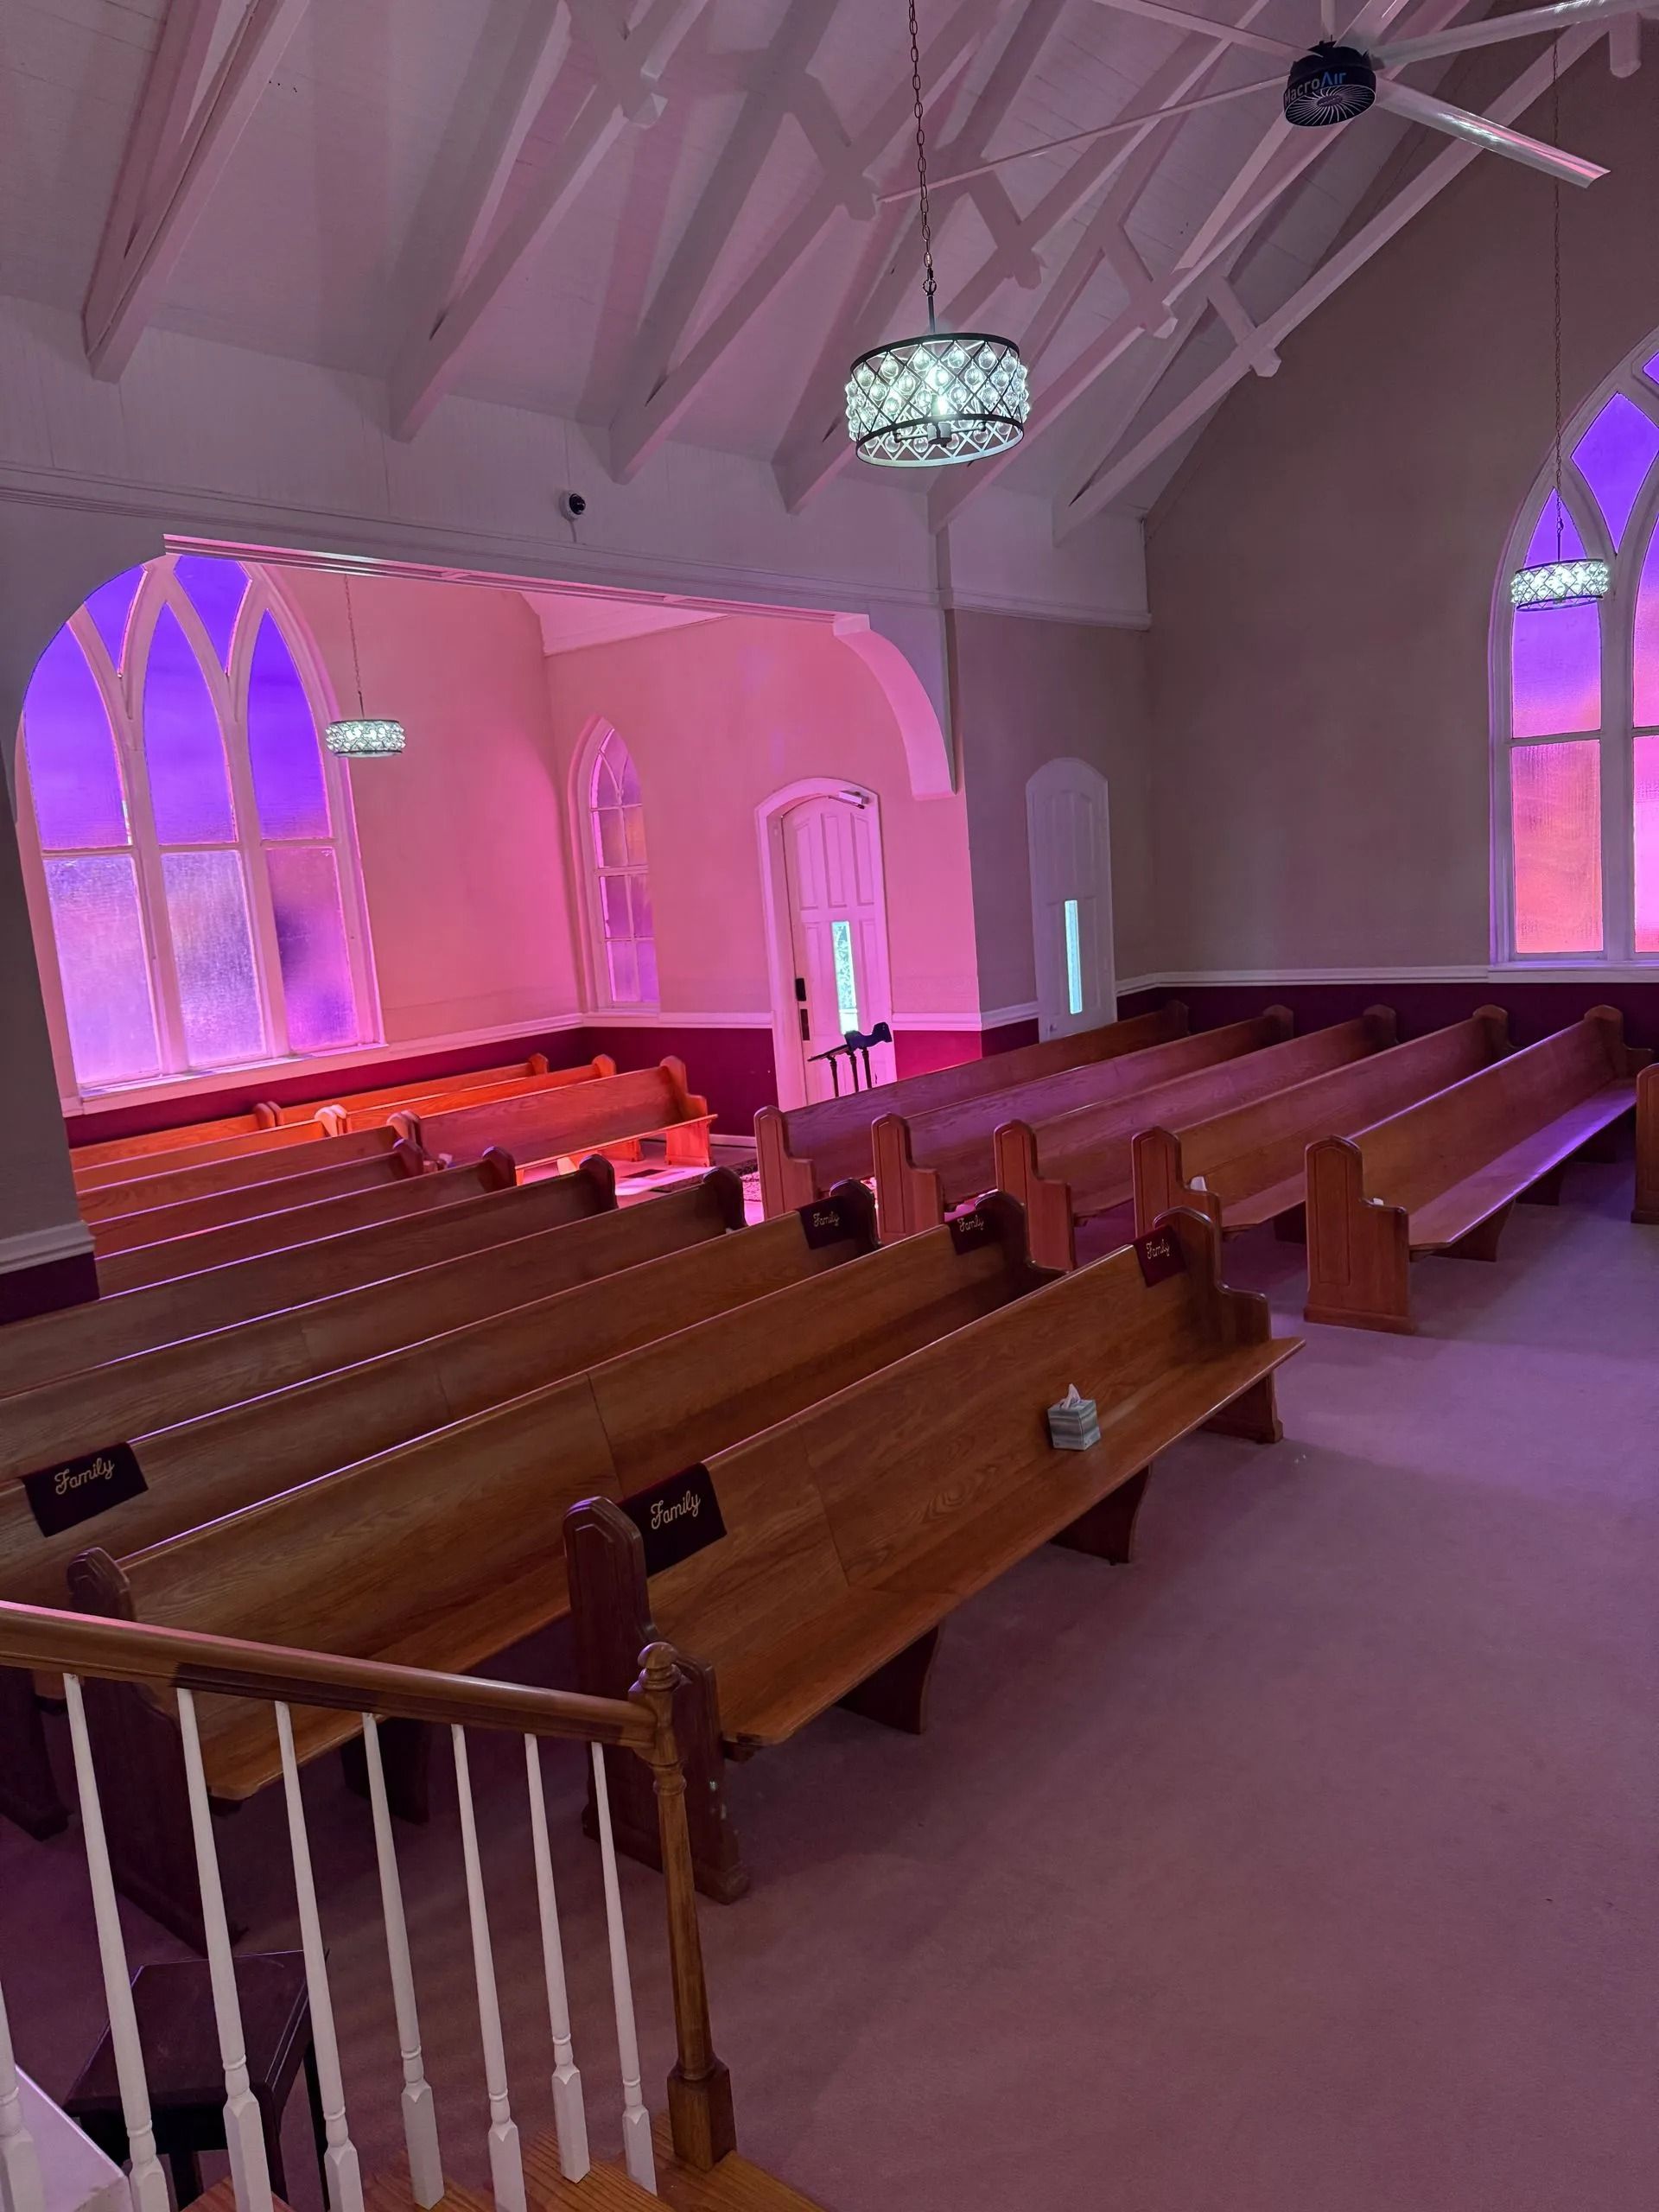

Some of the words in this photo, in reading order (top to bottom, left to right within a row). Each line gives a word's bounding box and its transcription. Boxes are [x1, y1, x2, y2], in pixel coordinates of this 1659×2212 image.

[1284, 72, 1346, 104] MacroAir
[813, 1211, 840, 1227] Family
[957, 1214, 984, 1232] Family
[1146, 1238, 1170, 1260] Family
[54, 1458, 115, 1495] Family
[650, 1490, 701, 1529] Family
